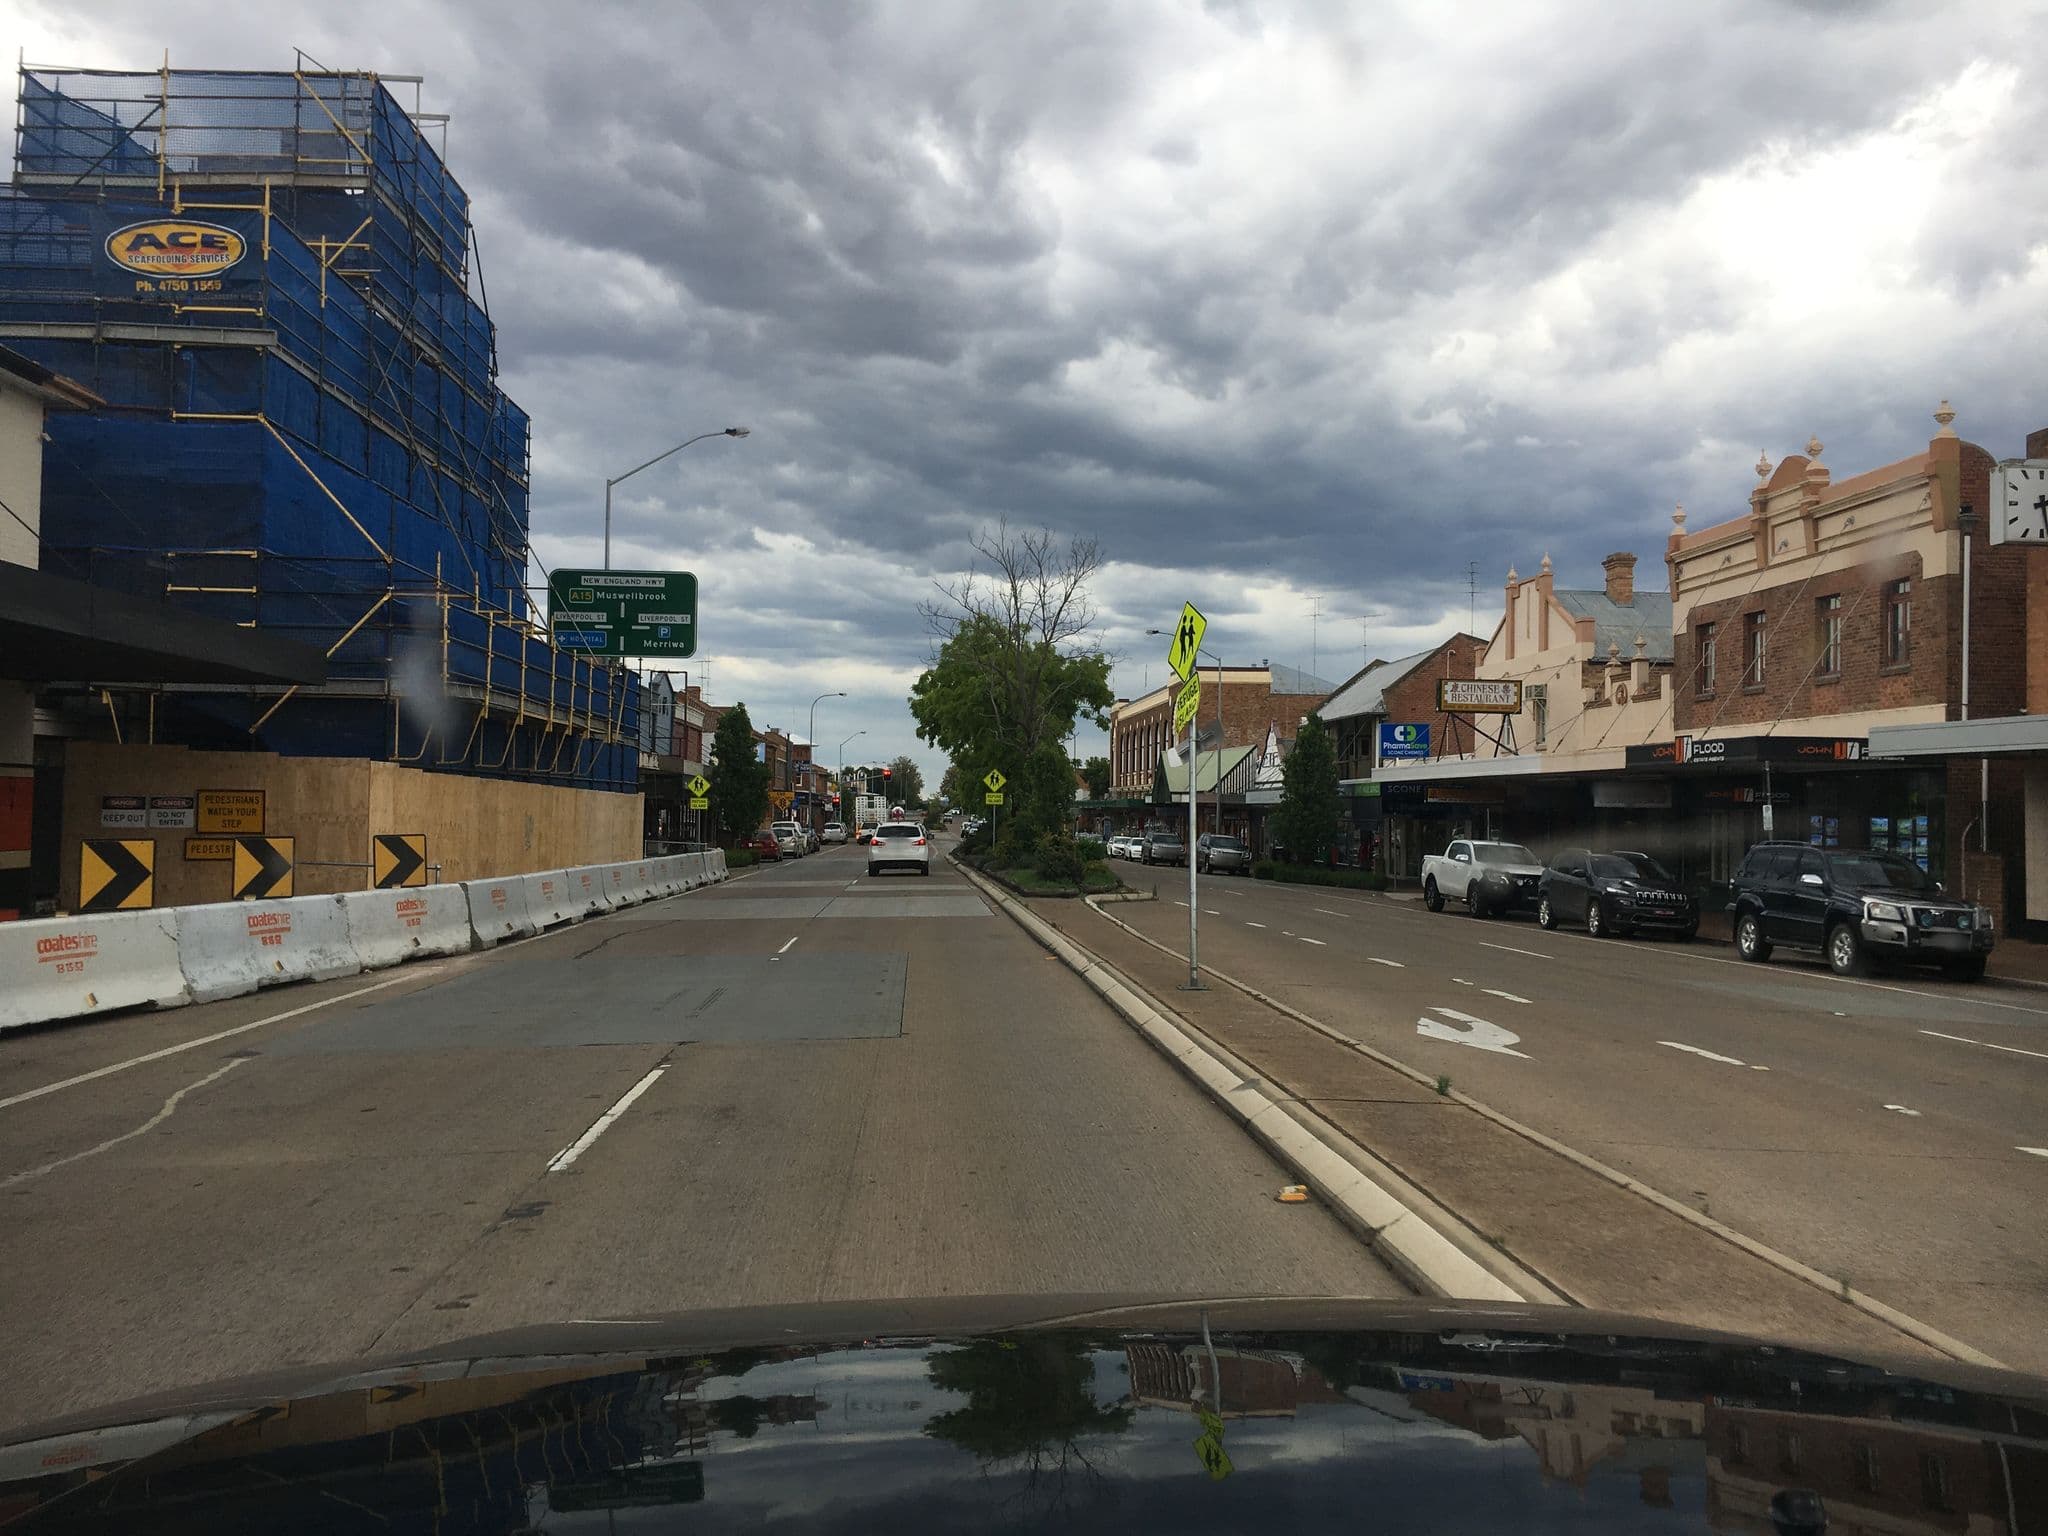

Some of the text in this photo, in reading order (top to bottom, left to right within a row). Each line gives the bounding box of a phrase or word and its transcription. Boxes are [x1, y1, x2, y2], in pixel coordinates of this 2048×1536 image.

[125, 231, 228, 251] ACE
[128, 253, 231, 264] SCAFFOLDING SERVICES
[136, 280, 156, 292] Ph.
[159, 280, 188, 291] 4750
[571, 591, 667, 601] A15 Muswellbrook
[555, 613, 594, 621] LIVERPOOL
[640, 615, 678, 623] LIVERPOOL
[570, 635, 604, 643] HOSPITAL
[643, 640, 685, 649] Merriwa
[1460, 684, 1500, 694] CHINESE
[1177, 679, 1198, 710] REFUGE
[1450, 692, 1510, 703] RESTAURANT
[1694, 742, 1724, 754] FLOOD
[1798, 746, 1832, 754] JOHN
[204, 796, 260, 806] PEDESTRIANS
[207, 808, 257, 816] WATCH YOUR
[103, 814, 144, 823] KEEP OUT
[222, 820, 242, 828] STEP
[191, 845, 231, 854] PEDESTR
